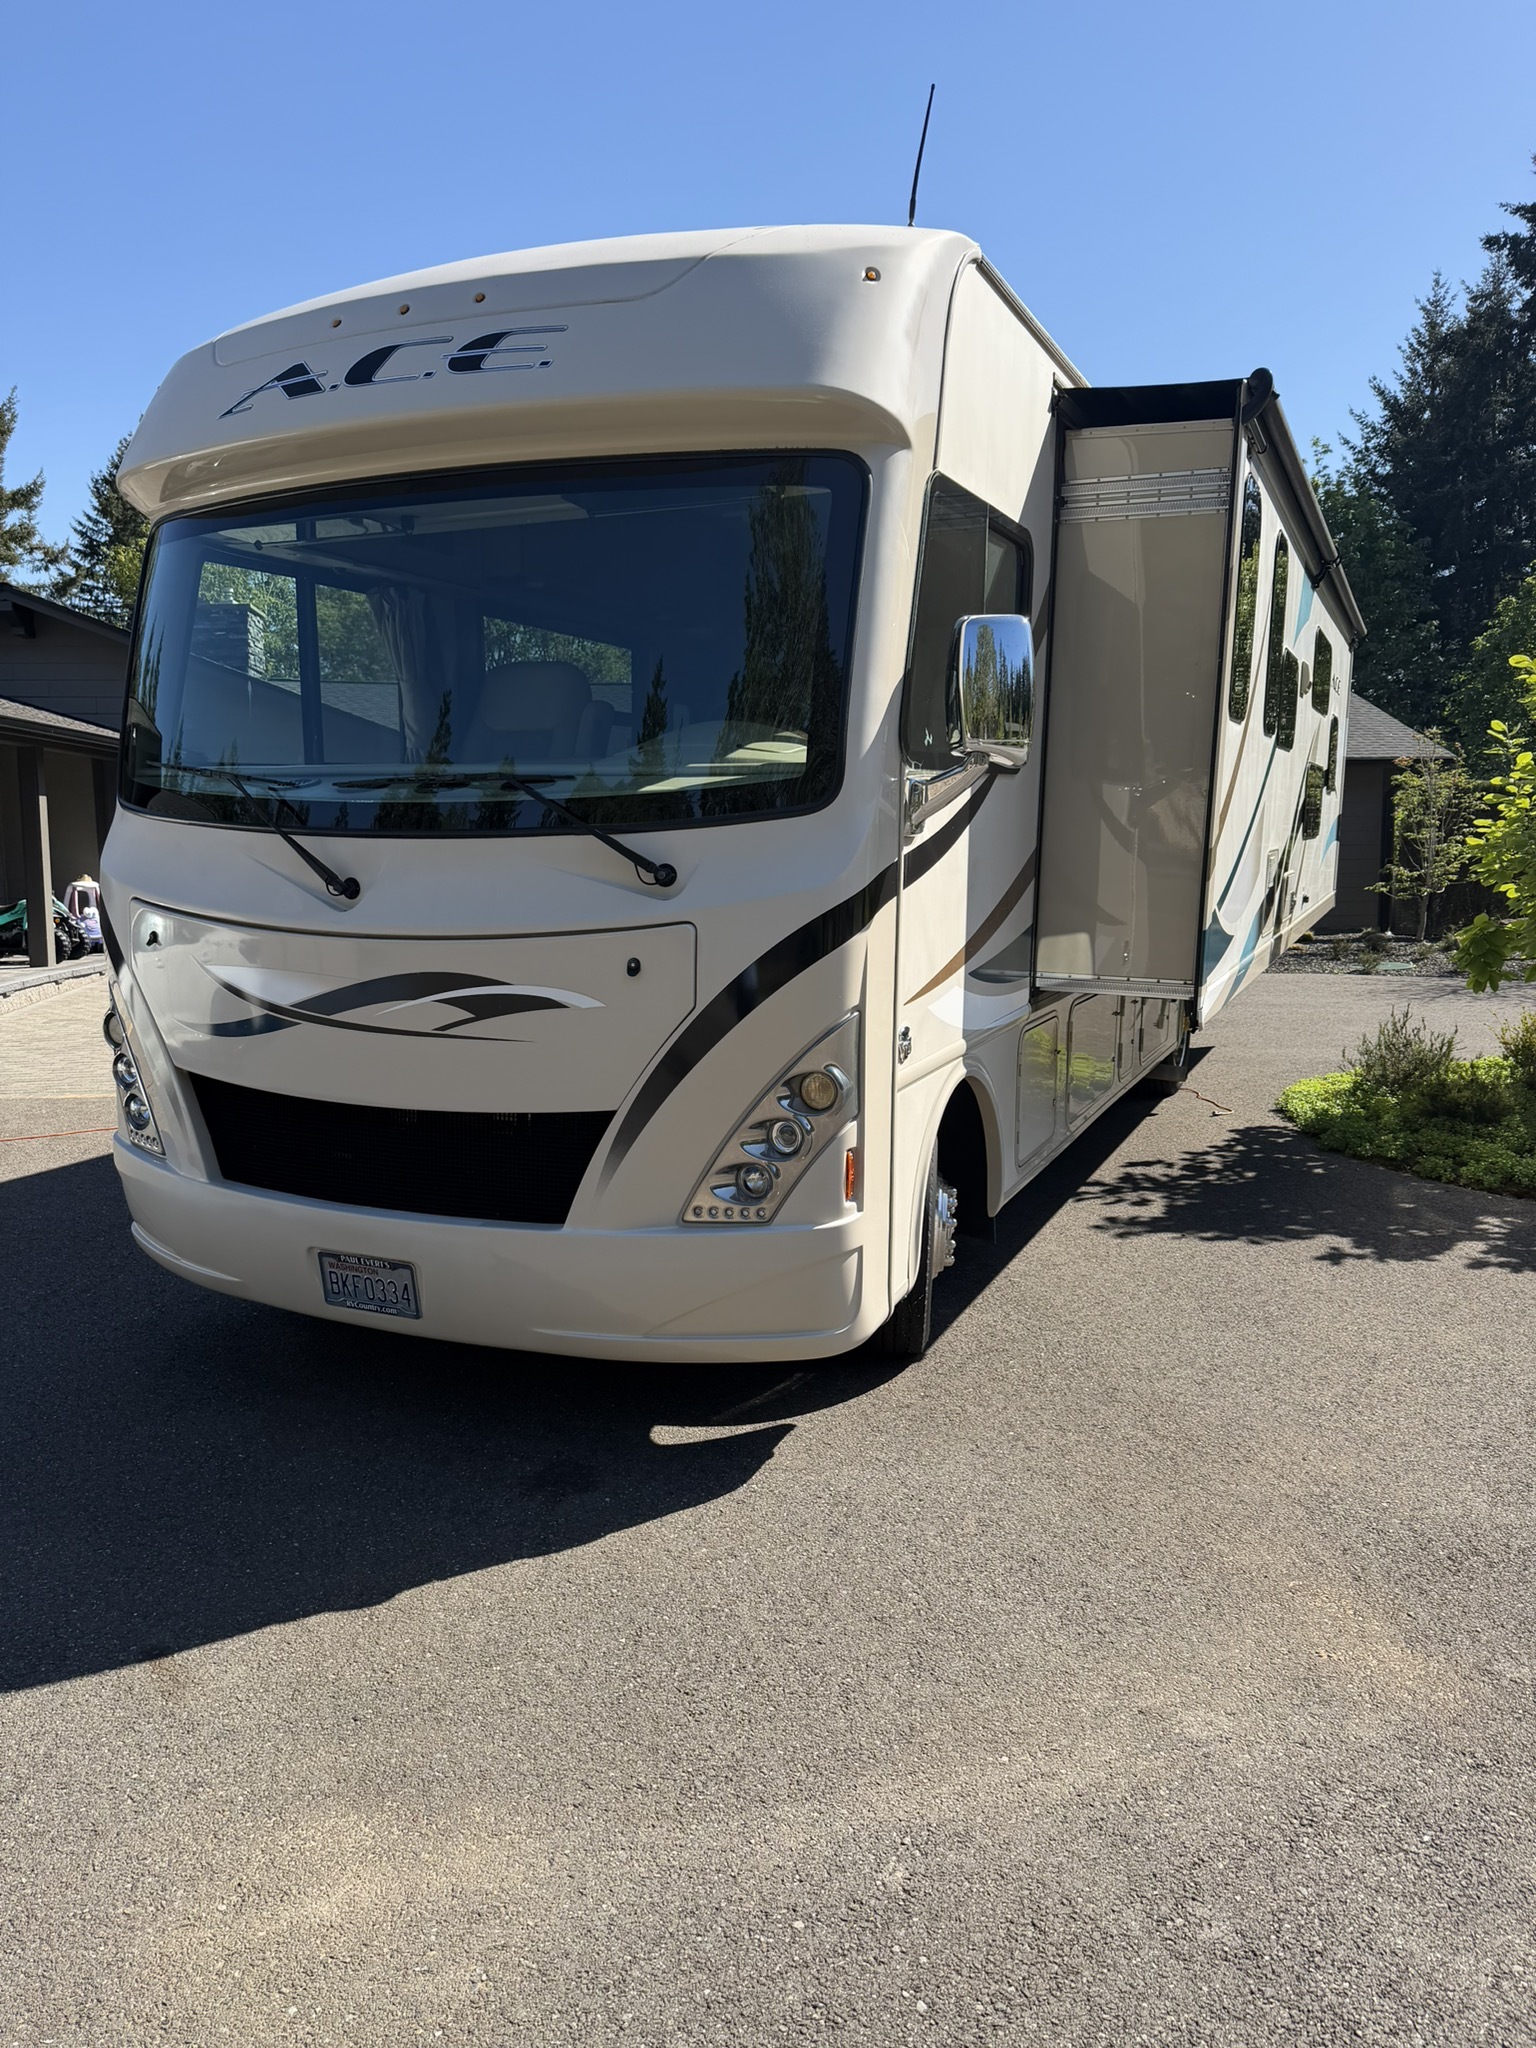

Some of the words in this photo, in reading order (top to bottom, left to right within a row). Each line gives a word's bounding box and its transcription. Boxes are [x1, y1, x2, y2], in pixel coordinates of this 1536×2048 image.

[218, 325, 568, 419] A.C.E.
[328, 1261, 379, 1276] WASHINGTON
[341, 1255, 358, 1264] PAUL
[329, 1270, 411, 1307] BKF0334
